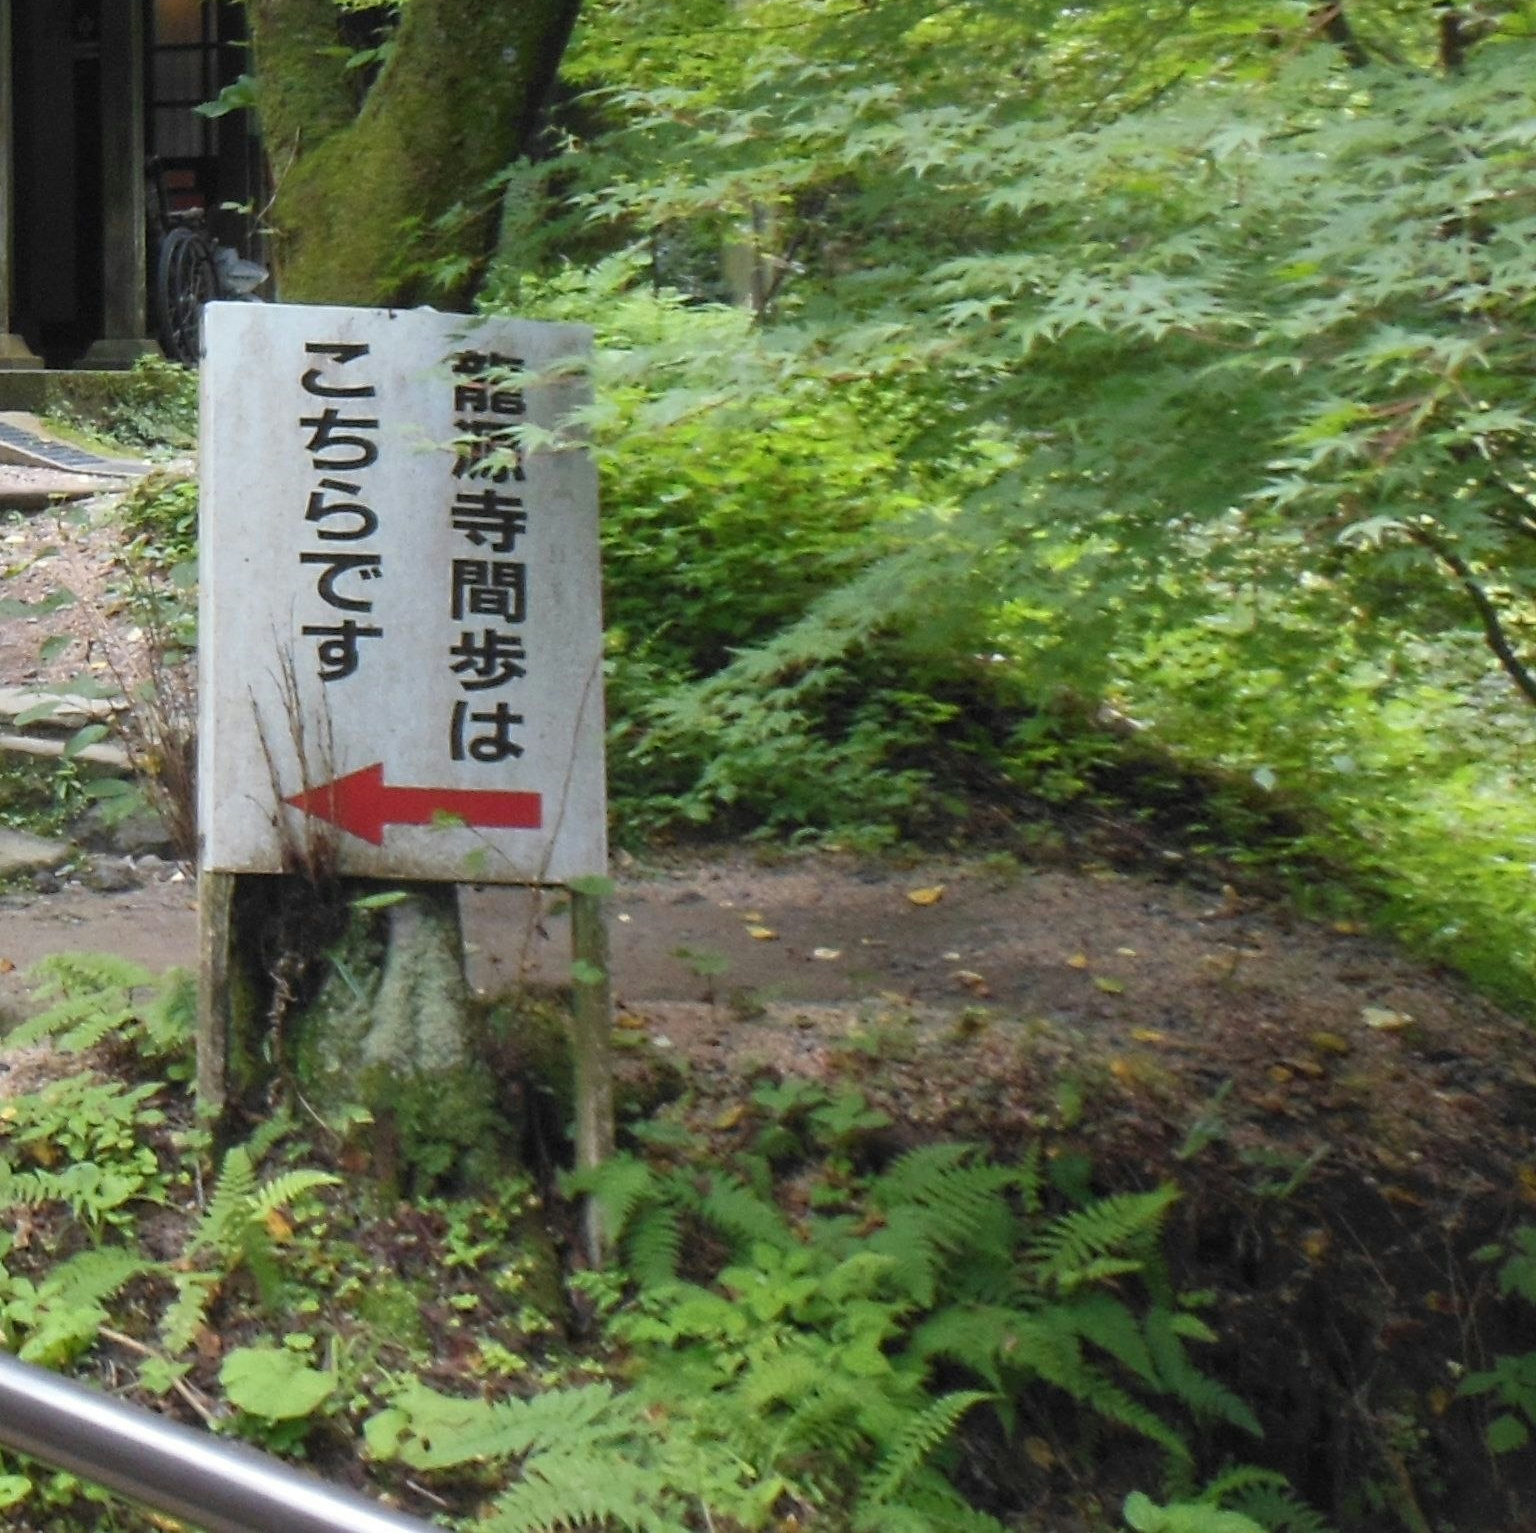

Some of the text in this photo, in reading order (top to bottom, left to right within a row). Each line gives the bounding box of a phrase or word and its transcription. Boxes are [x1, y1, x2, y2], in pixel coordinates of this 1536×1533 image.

[298, 341, 384, 682] こちらです
